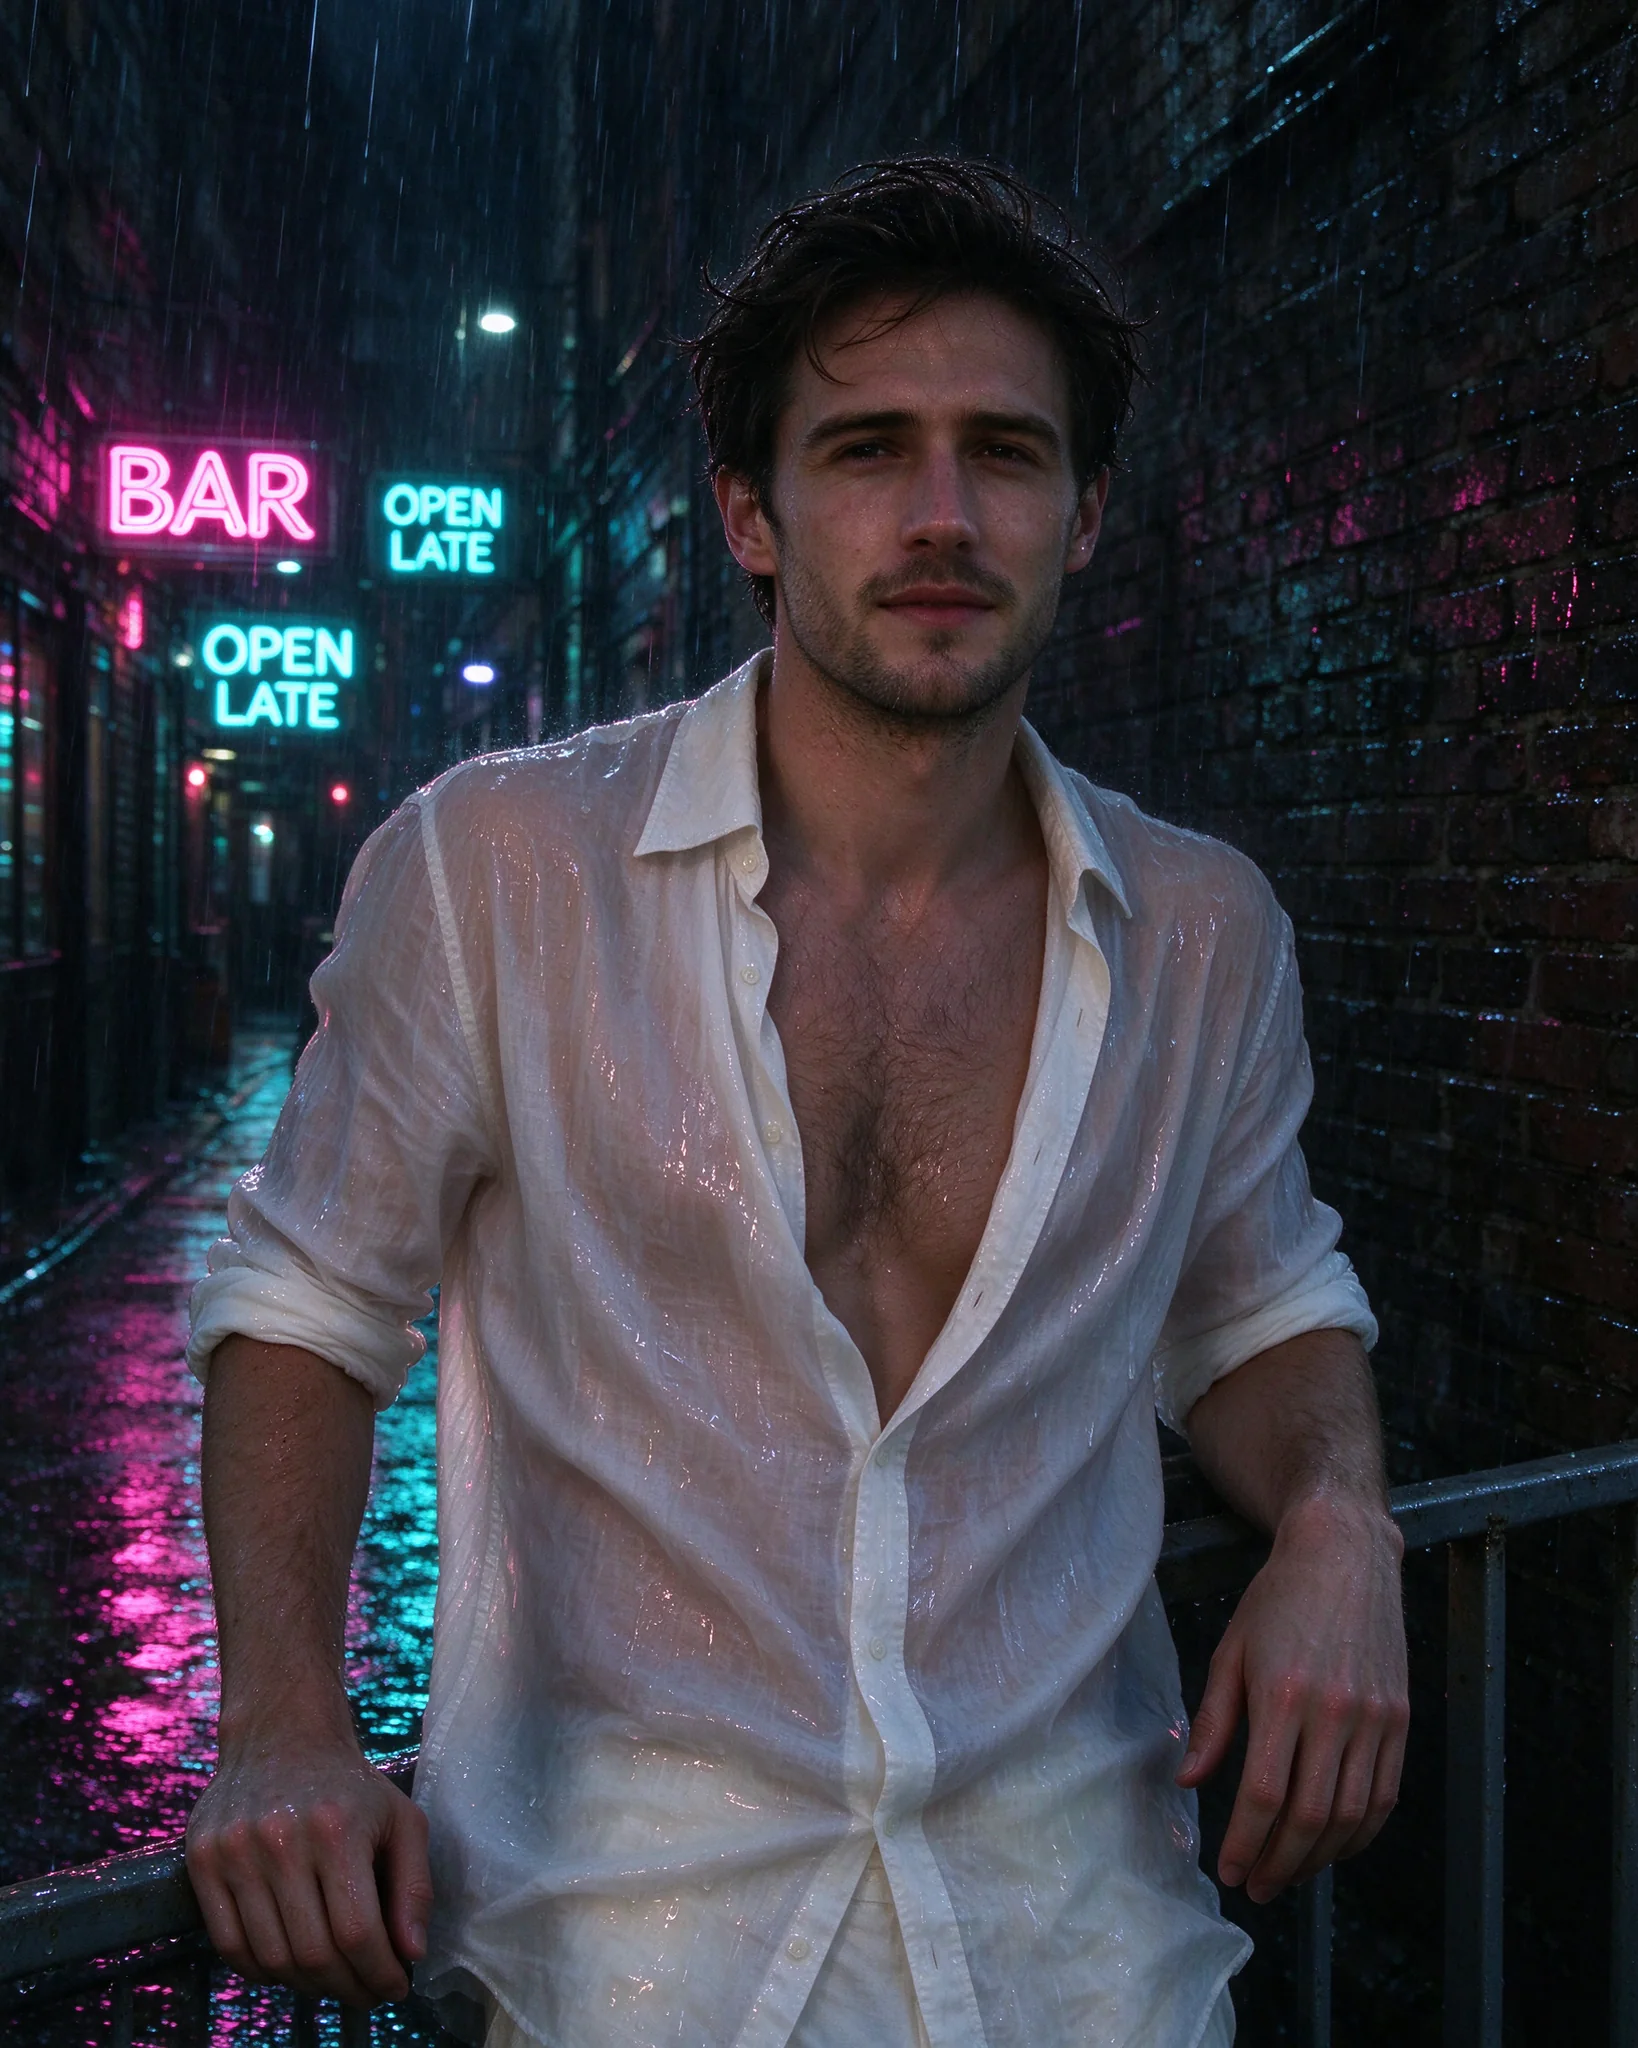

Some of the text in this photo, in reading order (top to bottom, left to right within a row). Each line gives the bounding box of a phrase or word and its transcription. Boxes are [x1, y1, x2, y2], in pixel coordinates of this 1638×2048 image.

[108, 444, 315, 540] BAR
[382, 482, 502, 528] OPEN
[389, 529, 495, 573] LATE
[202, 623, 354, 678] OPEN
[215, 681, 340, 729] LATE
